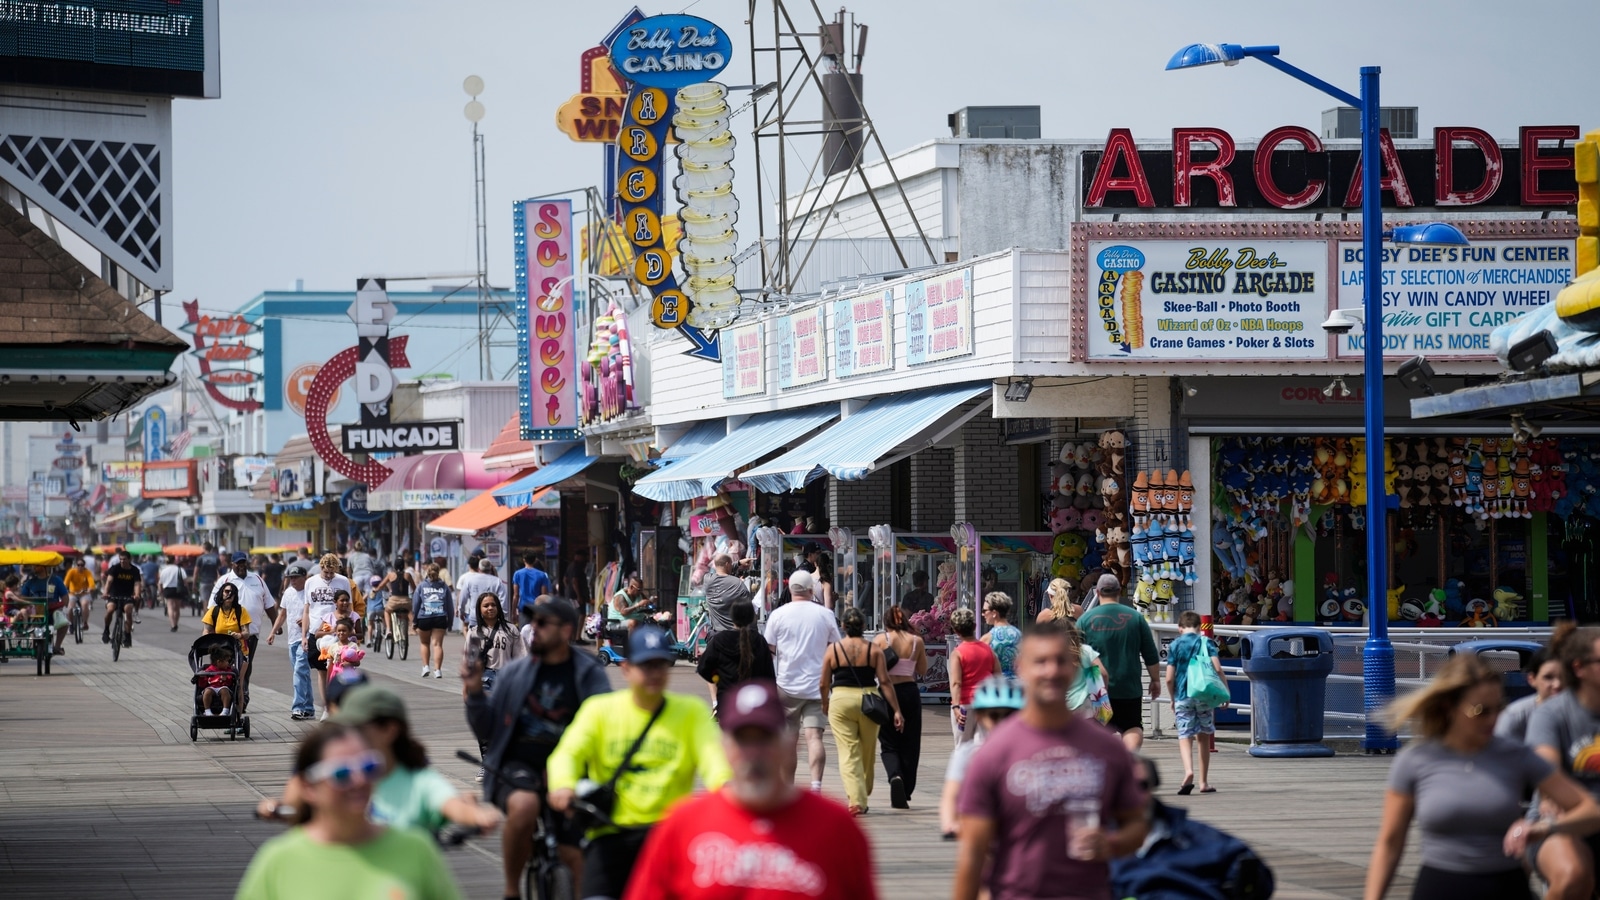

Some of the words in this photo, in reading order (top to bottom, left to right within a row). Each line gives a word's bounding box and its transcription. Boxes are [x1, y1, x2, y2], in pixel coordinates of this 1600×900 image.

[43, 4, 59, 23] TO
[627, 28, 675, 55] Bobby
[622, 53, 725, 74] CASINO
[580, 96, 627, 117] SN
[1084, 125, 1580, 211] ARCADE
[627, 92, 678, 323] ARCADE
[1103, 250, 1120, 259] Bobby
[1103, 259, 1140, 268] CASINO
[1185, 247, 1233, 275] Bobby
[1234, 247, 1287, 269] Dee's
[1344, 248, 1401, 262] BOBY
[1409, 248, 1458, 262] DEE'S
[1462, 247, 1496, 261] FUN
[1503, 247, 1569, 261] CENTER
[1151, 272, 1226, 295] CASINO
[1232, 272, 1315, 297] ARCADE
[1342, 270, 1396, 286] LARST
[1401, 269, 1465, 285] SELECTION
[1467, 269, 1481, 285] of
[1482, 268, 1571, 284] MERCHANDISE
[1101, 271, 1121, 343] ARCADE
[1164, 301, 1218, 312] Skee-Ball
[1228, 301, 1263, 312] Photo
[1266, 301, 1300, 312] Booth
[1382, 291, 1401, 307] SY
[1408, 291, 1438, 306] WIN
[1445, 291, 1496, 306] CANDY
[1157, 318, 1199, 331] Wizard
[1201, 318, 1214, 331] of
[1215, 319, 1231, 331] Oz
[1240, 319, 1264, 331] NBA
[1266, 319, 1304, 334] Hoops
[1381, 310, 1422, 327] Win
[1426, 312, 1462, 327] GIFT
[1150, 337, 1184, 348] Crane
[1186, 337, 1225, 348] Games
[1236, 337, 1270, 348] Poker
[1272, 337, 1281, 348] &
[1284, 337, 1315, 348] Slots
[1348, 334, 1408, 350] NOODY
[1414, 334, 1442, 349] HAS
[1448, 333, 1490, 349] MORE
[348, 426, 453, 449] FUNCADE
